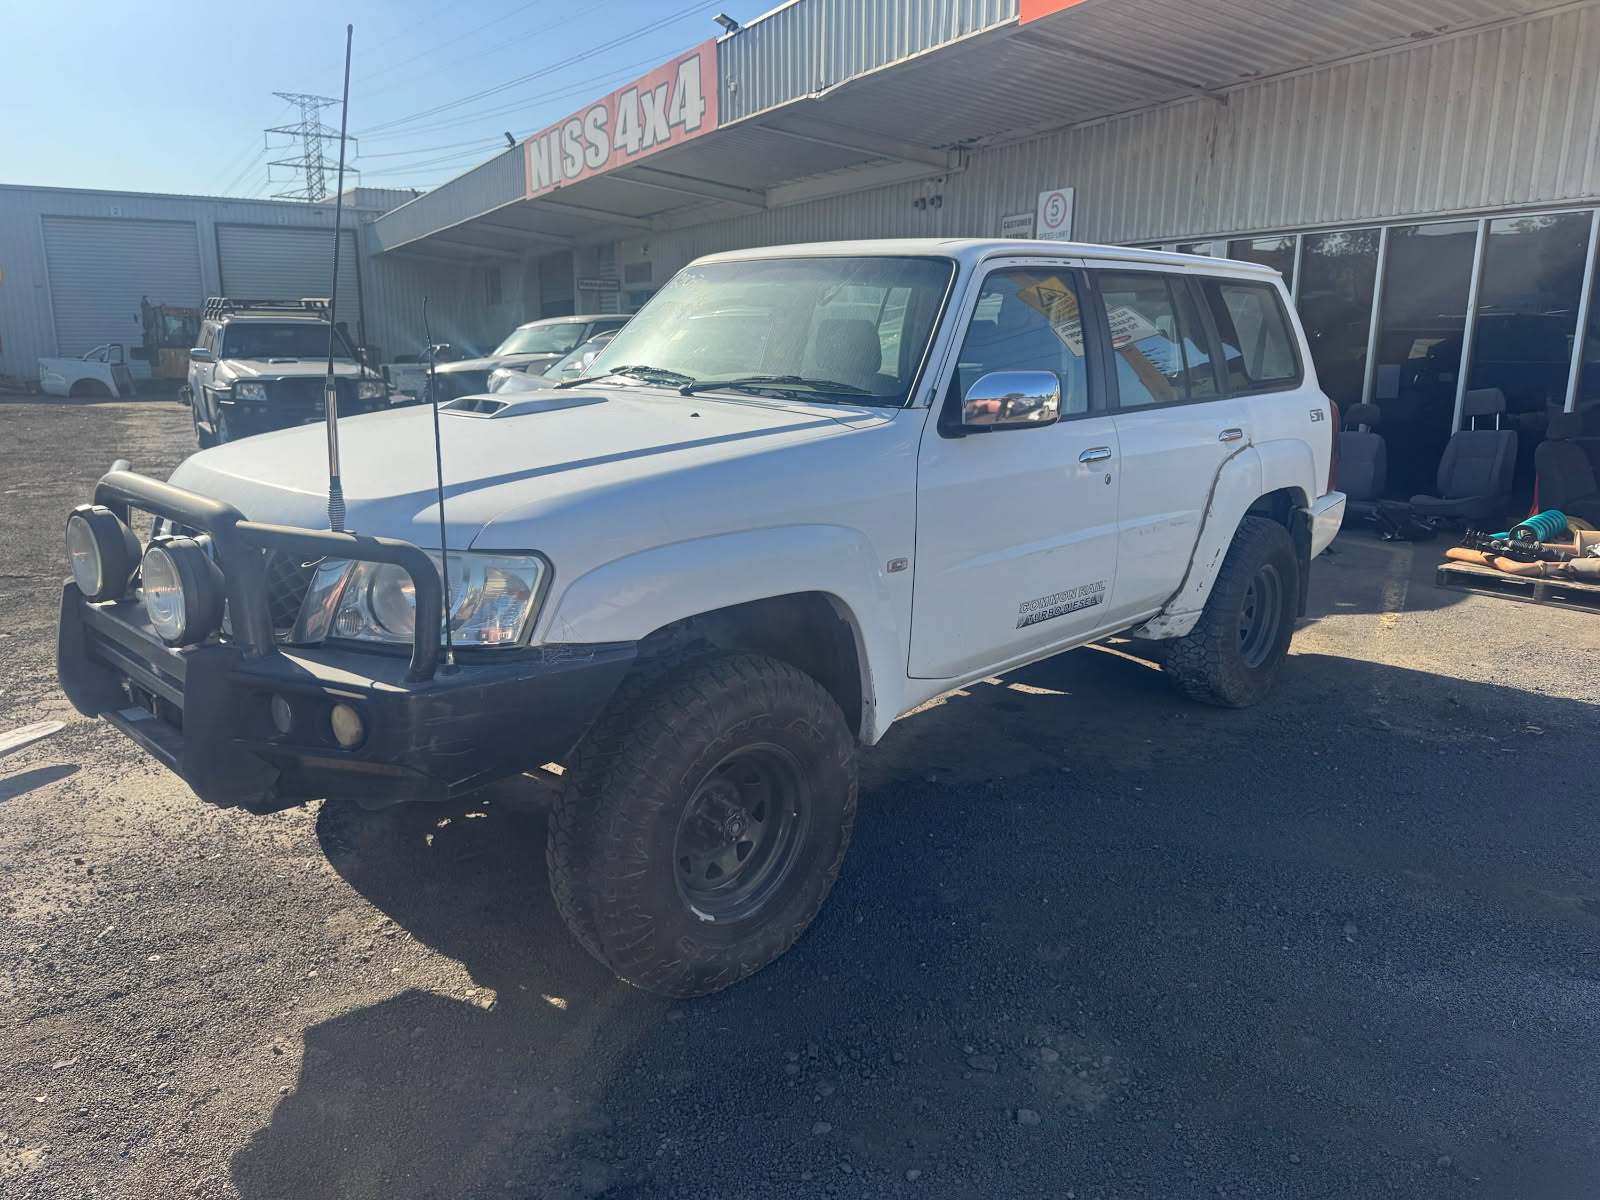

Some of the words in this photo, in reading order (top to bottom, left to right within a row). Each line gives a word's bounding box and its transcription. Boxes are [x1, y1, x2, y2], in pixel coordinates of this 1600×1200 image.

[1051, 198, 1060, 217] 5
[1019, 587, 1079, 614] COMMON
[1079, 580, 1106, 598] RAIL
[1026, 605, 1062, 624] TURBO
[1063, 595, 1097, 613] DIESEL
